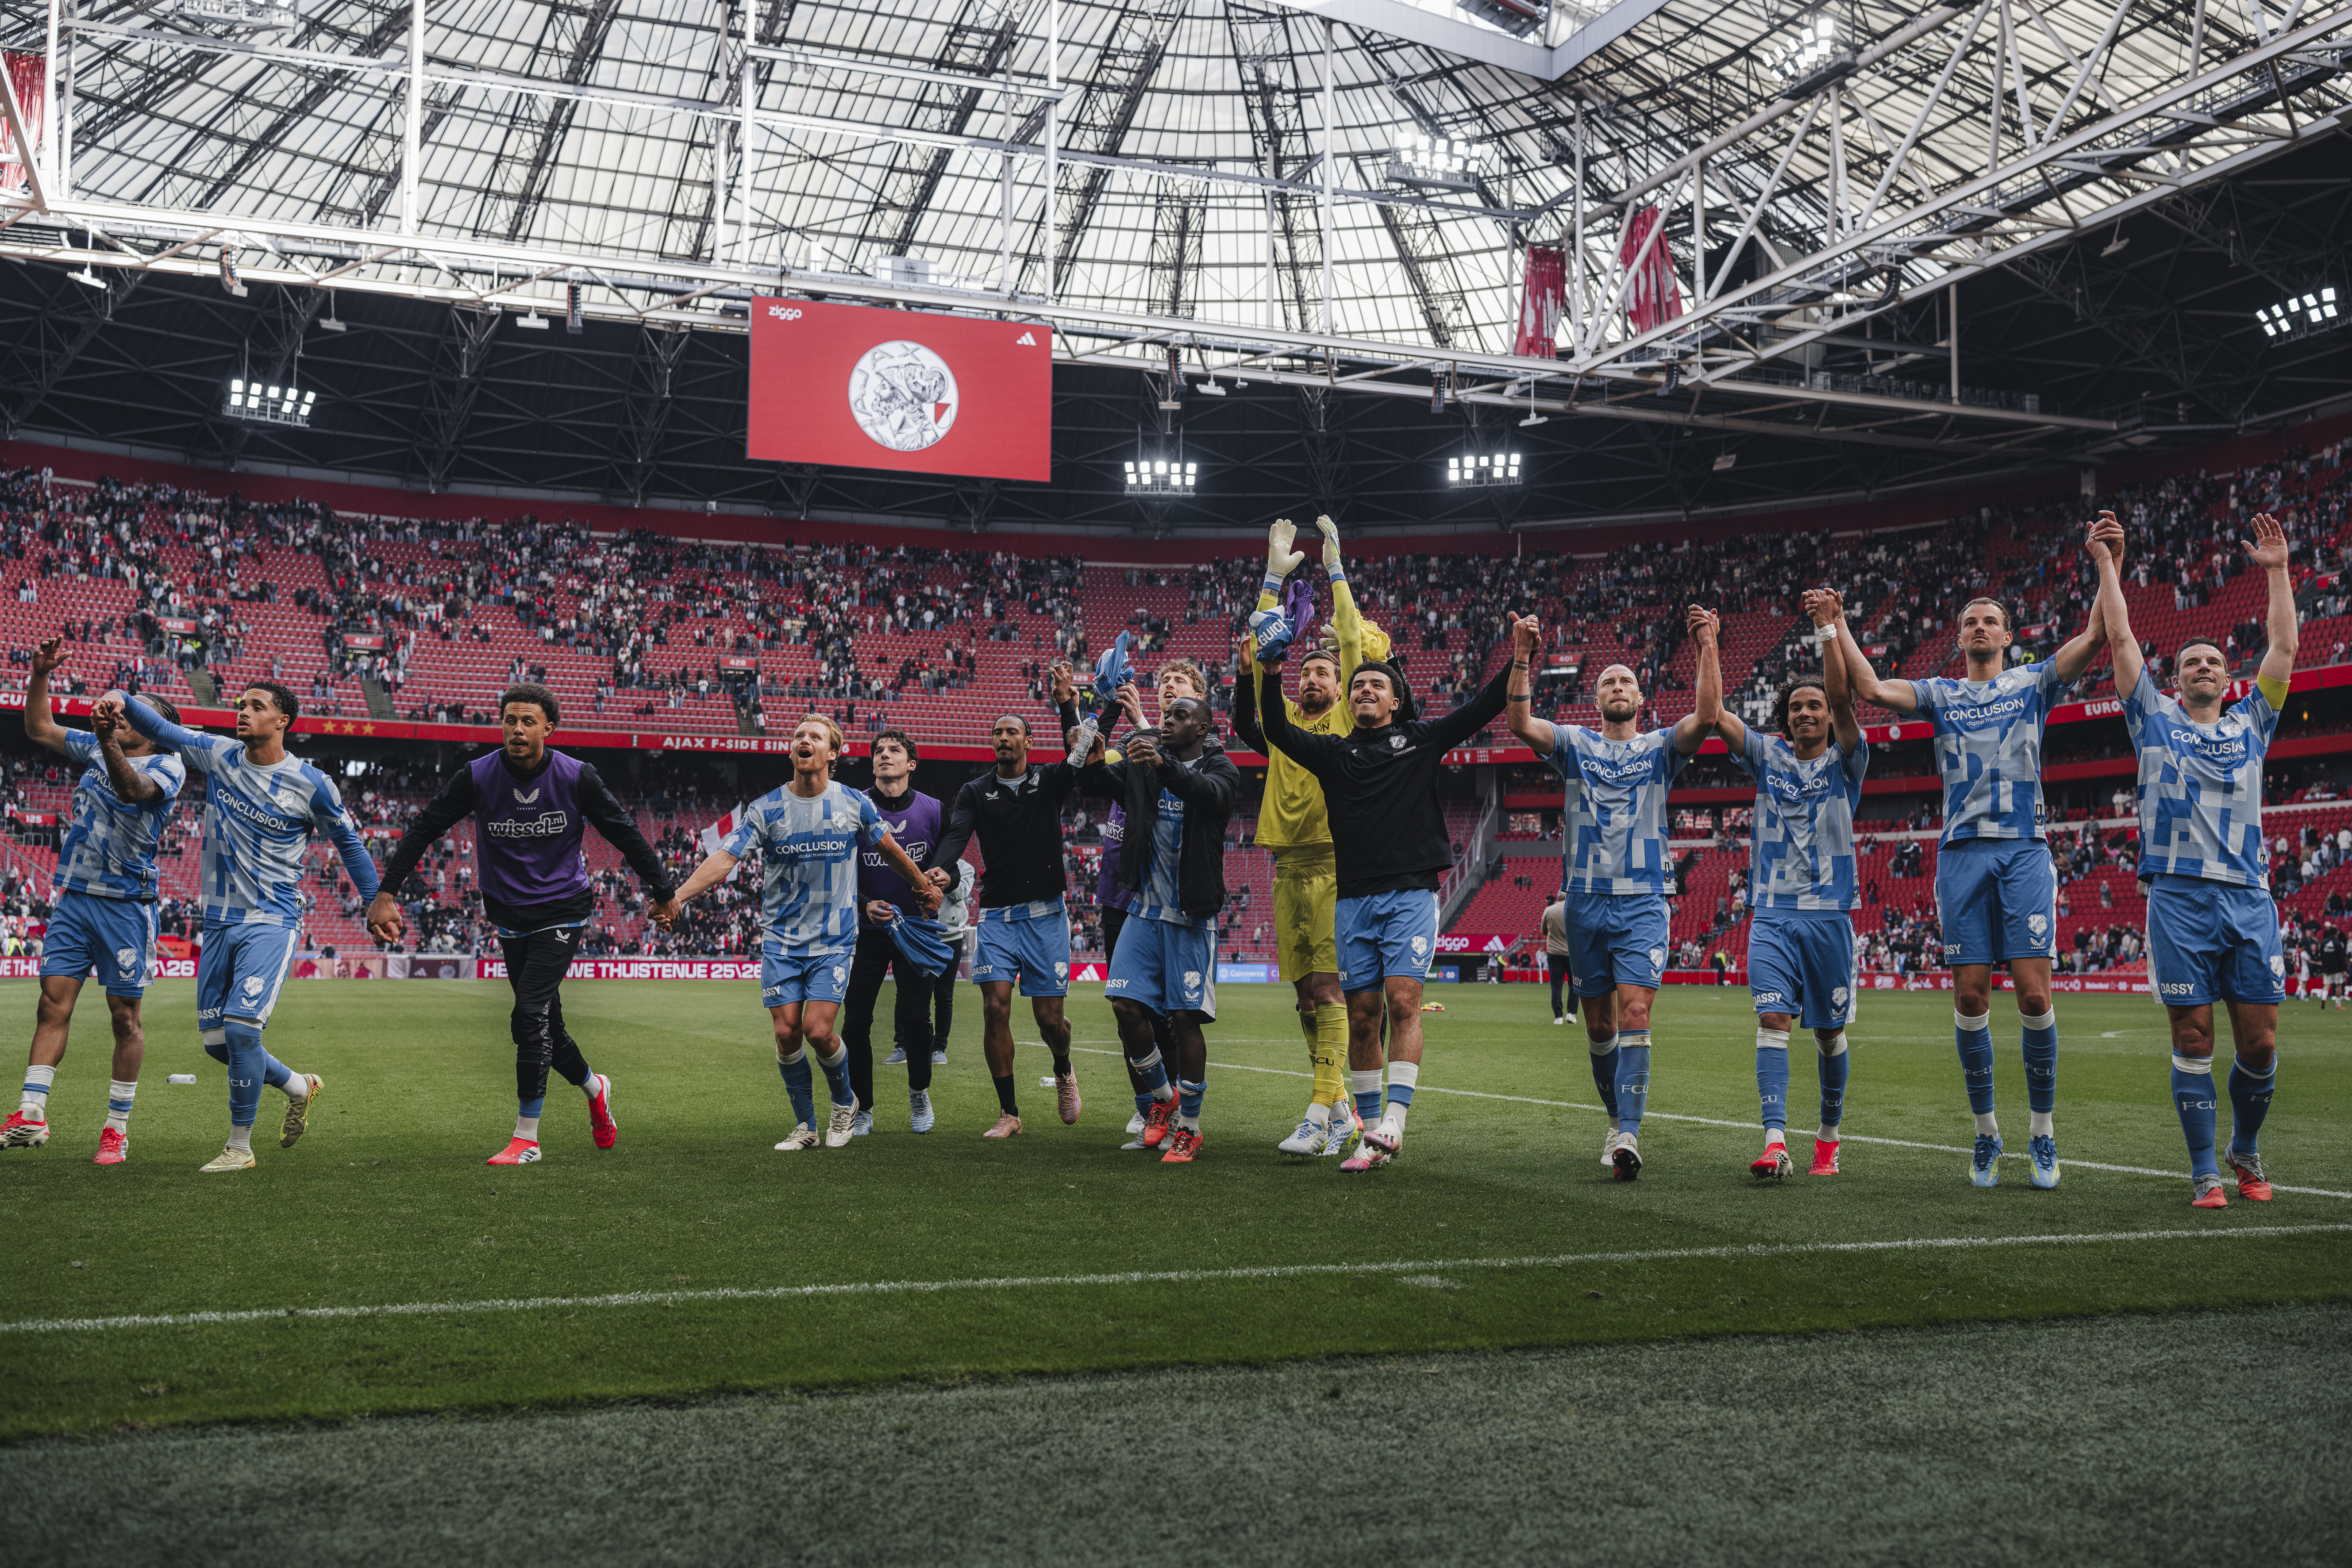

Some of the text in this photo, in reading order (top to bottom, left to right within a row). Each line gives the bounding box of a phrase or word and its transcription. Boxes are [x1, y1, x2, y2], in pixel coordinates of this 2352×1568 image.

[769, 305, 802, 320] ziggo
[1944, 698, 2025, 721] CONCLUSION
[2085, 700, 2124, 716] EURO
[1966, 711, 2021, 727] digital transformatio
[663, 736, 794, 751] AJAX F-SIDE SIN
[1393, 745, 1417, 756] CONCLUSION
[1581, 759, 1653, 778] CONCLUSION
[1767, 775, 1829, 797] CONCLSION
[216, 789, 289, 831] CONCLUSION
[232, 811, 285, 836] digital transformation
[488, 811, 567, 838] wissel.nl
[775, 841, 847, 855] CONCLUSION
[1436, 935, 1469, 952] ziggo
[484, 962, 508, 978] HE
[598, 963, 708, 979] THUISTENUE
[2161, 983, 2194, 994] DASSY
[1316, 1057, 1334, 1066] CU
[2025, 1062, 2055, 1076] FCU
[1964, 1065, 1992, 1076] FCU
[1761, 1094, 1777, 1105] CU
[2183, 1100, 2217, 1110] FCU
[2250, 1094, 2273, 1103] FC
